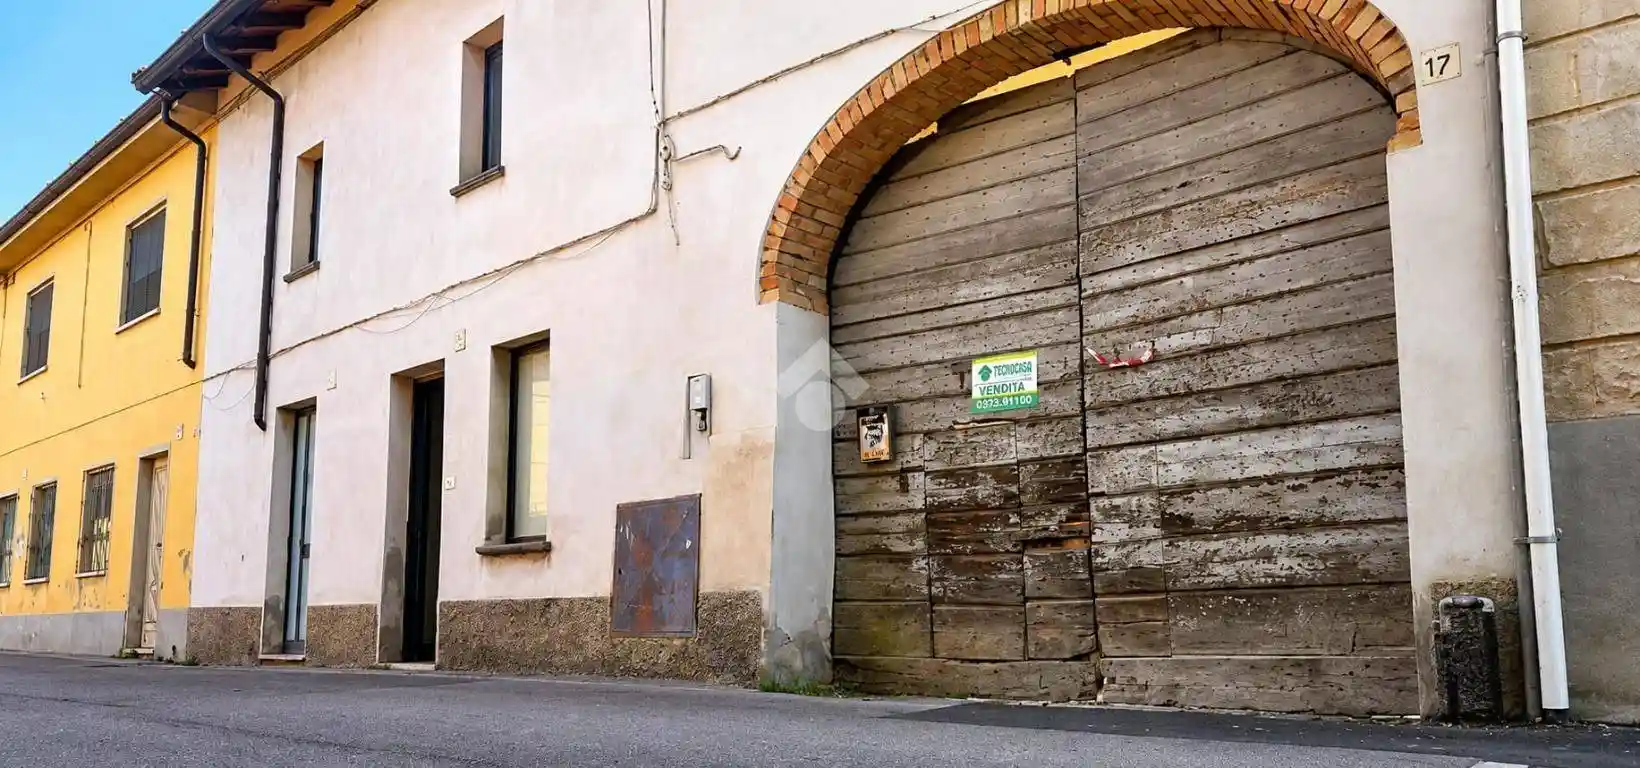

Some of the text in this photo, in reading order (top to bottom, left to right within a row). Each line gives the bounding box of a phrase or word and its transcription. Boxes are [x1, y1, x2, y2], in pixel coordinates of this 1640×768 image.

[1424, 53, 1450, 77] 17
[993, 361, 1032, 378] TECNOCASA
[979, 382, 1026, 396] VENDITA
